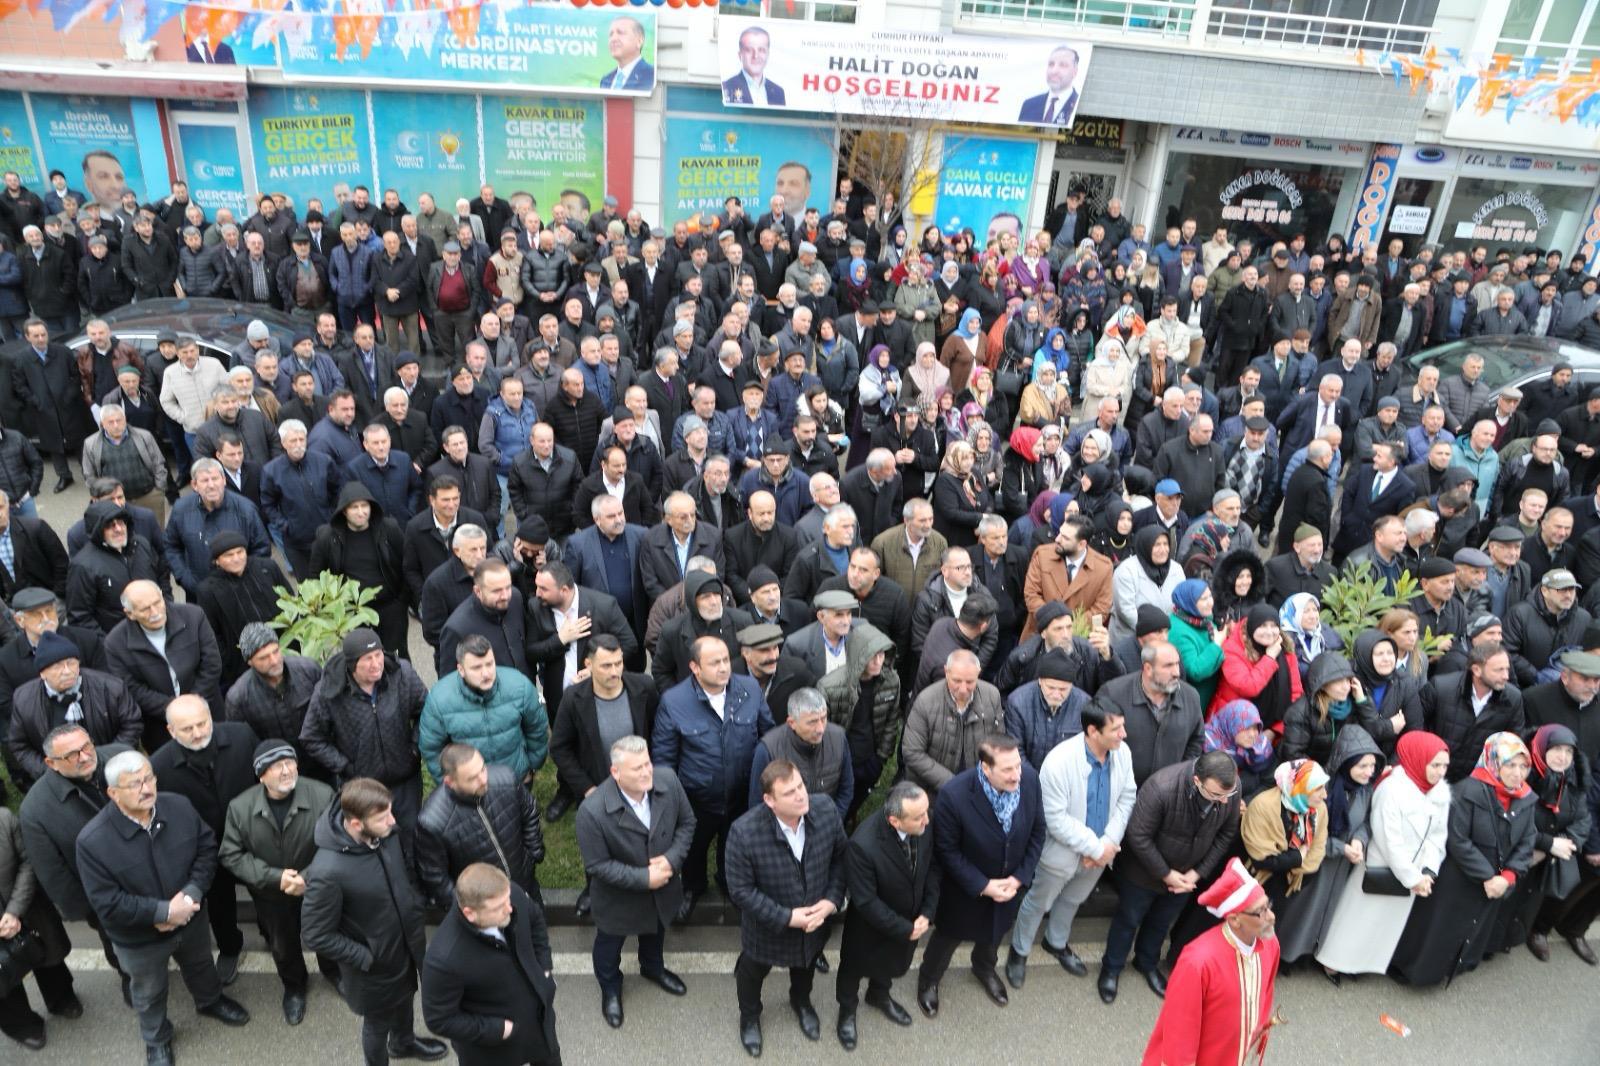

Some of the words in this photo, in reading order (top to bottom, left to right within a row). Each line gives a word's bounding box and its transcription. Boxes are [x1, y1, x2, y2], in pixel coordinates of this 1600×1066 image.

[554, 25, 598, 38] KAVAK
[828, 54, 894, 75] HALİT
[901, 59, 979, 80] DOĞAN
[802, 73, 1001, 104] HOŞGELDİNİZ
[506, 107, 549, 119] KAVAK
[505, 120, 586, 139] GERÇEK
[1274, 138, 1302, 148] BOSCH
[507, 149, 526, 161] AK
[681, 159, 724, 169] KAVAK
[269, 166, 289, 178] AK
[945, 168, 981, 182] DAHA
[944, 182, 993, 199] KAVAK
[678, 199, 695, 209] AK
